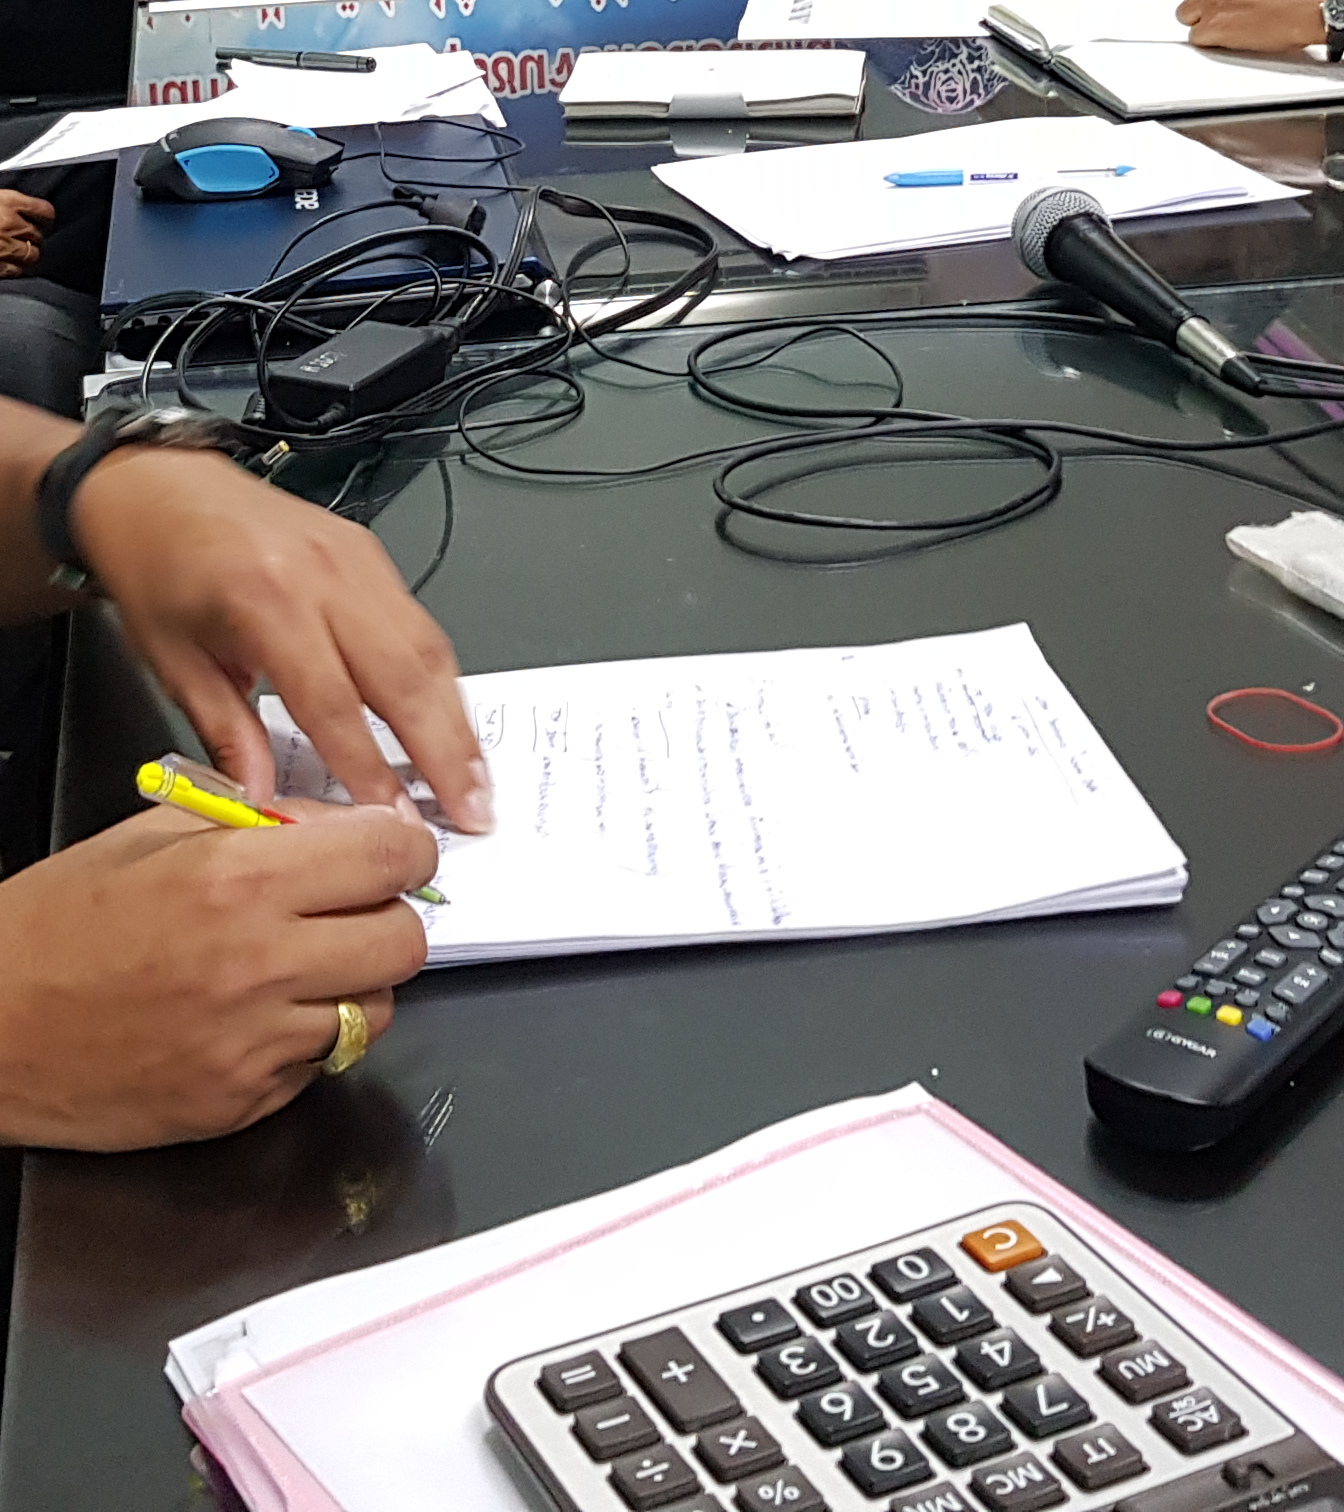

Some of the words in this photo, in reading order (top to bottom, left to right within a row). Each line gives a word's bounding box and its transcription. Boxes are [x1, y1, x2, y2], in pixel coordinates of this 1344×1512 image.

[295, 188, 320, 211] ace
[982, 1227, 1018, 1251] C
[896, 1254, 930, 1280] 0
[810, 1276, 862, 1308] 00
[940, 1296, 970, 1323] 1
[855, 1318, 896, 1348] 2
[779, 1345, 818, 1376] 3
[980, 1339, 1012, 1368] 4
[1118, 1349, 1170, 1381] MU
[901, 1364, 940, 1396] 5
[820, 1392, 856, 1422] 6
[1035, 1383, 1070, 1417] 7
[946, 1412, 987, 1444] 8
[1177, 1404, 1219, 1431] AC
[870, 1438, 906, 1472] 9
[985, 1462, 1045, 1496] MC
